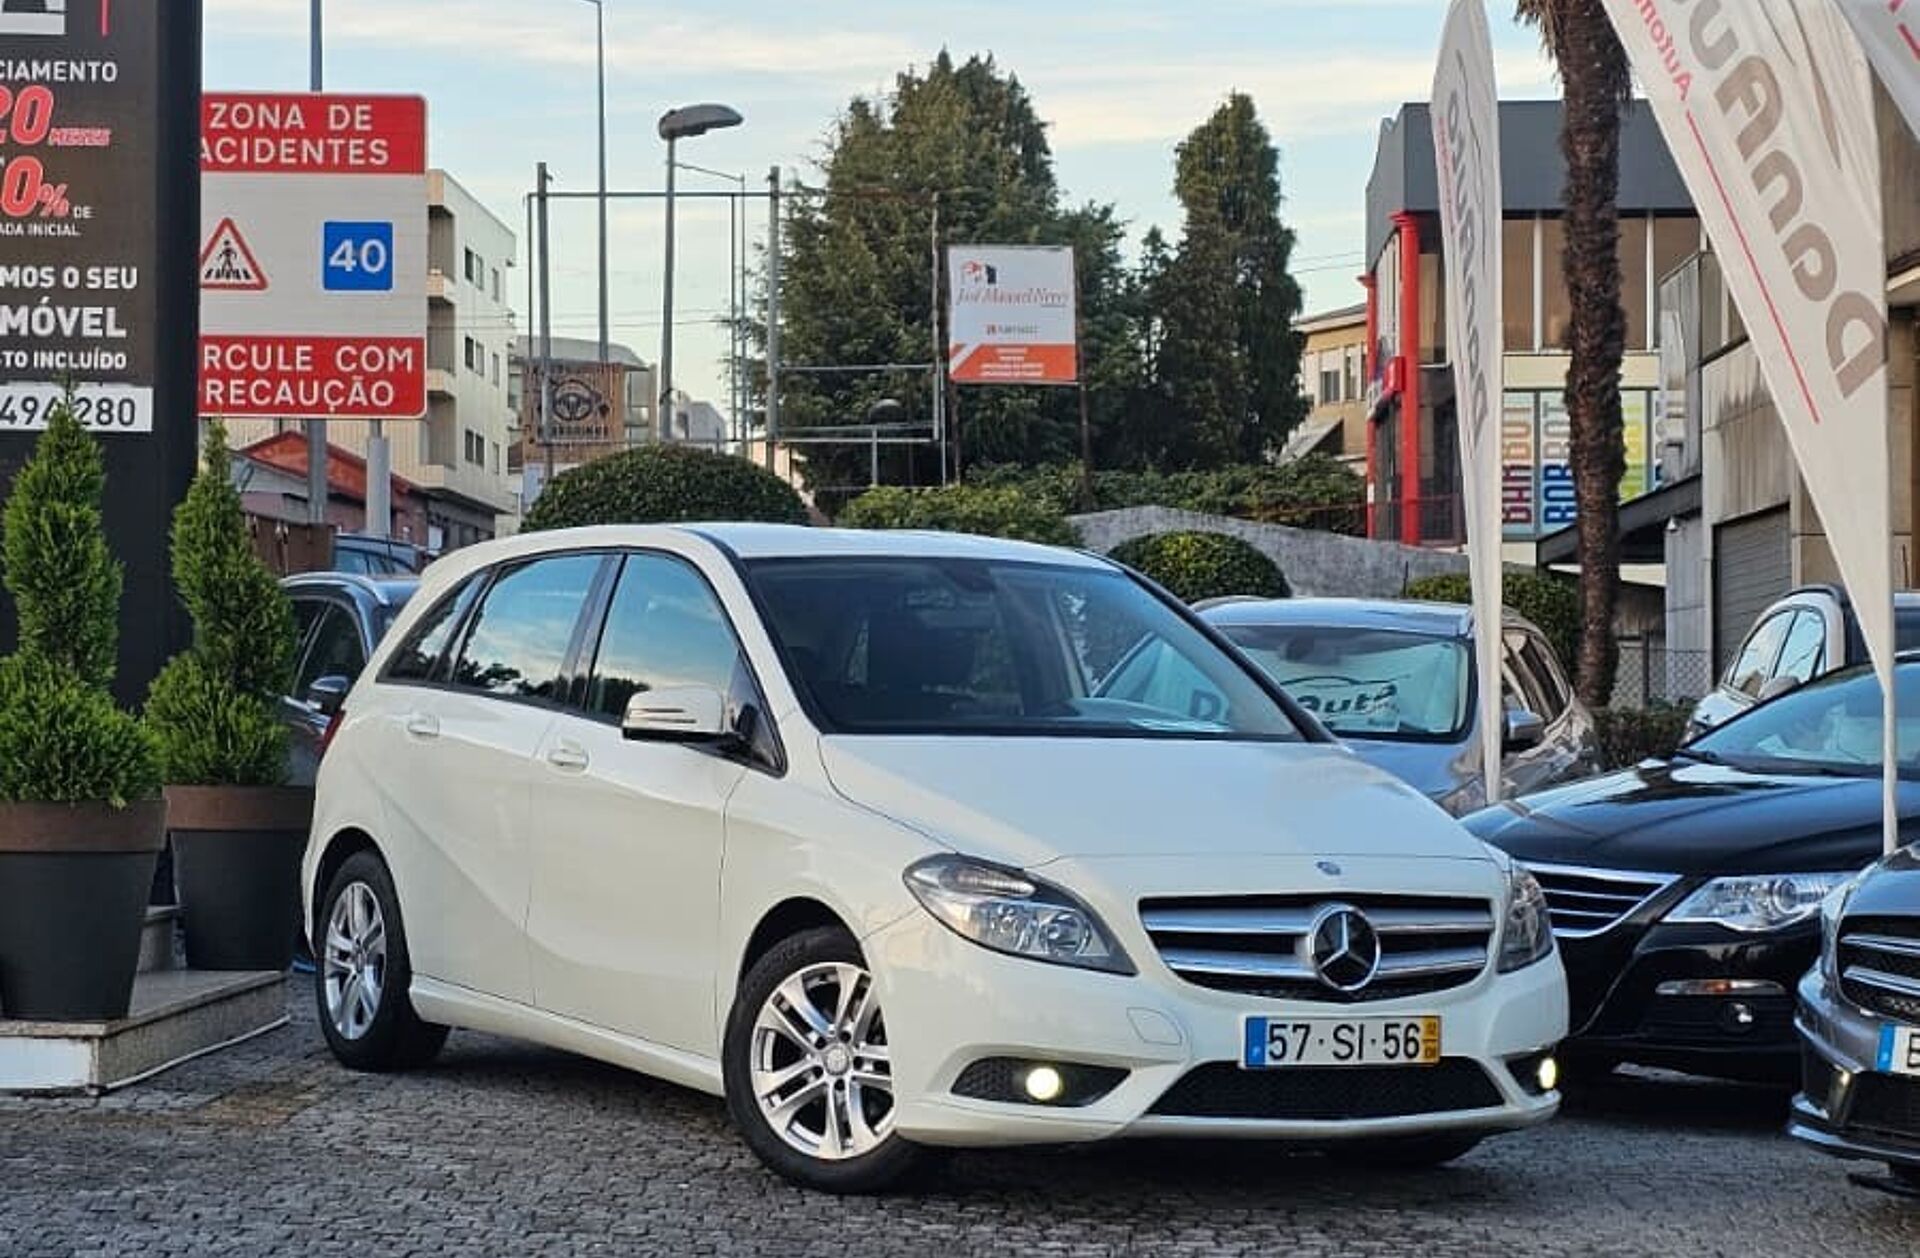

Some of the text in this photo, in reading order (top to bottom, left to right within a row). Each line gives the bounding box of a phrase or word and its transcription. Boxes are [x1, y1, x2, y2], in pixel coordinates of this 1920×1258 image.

[210, 102, 373, 131] ZONA DE
[200, 137, 389, 165] ACIDENTES
[73, 205, 94, 219] DE
[28, 223, 80, 236] INICIAL
[328, 238, 387, 274] 40
[0, 265, 138, 289] MOS O SEU
[0, 296, 127, 338] MÓVEL
[0, 346, 127, 370] TO INCLUÍDO
[203, 344, 413, 373] RCULE COM
[205, 376, 395, 413] RECAUÇÃO
[73, 397, 136, 426] 280
